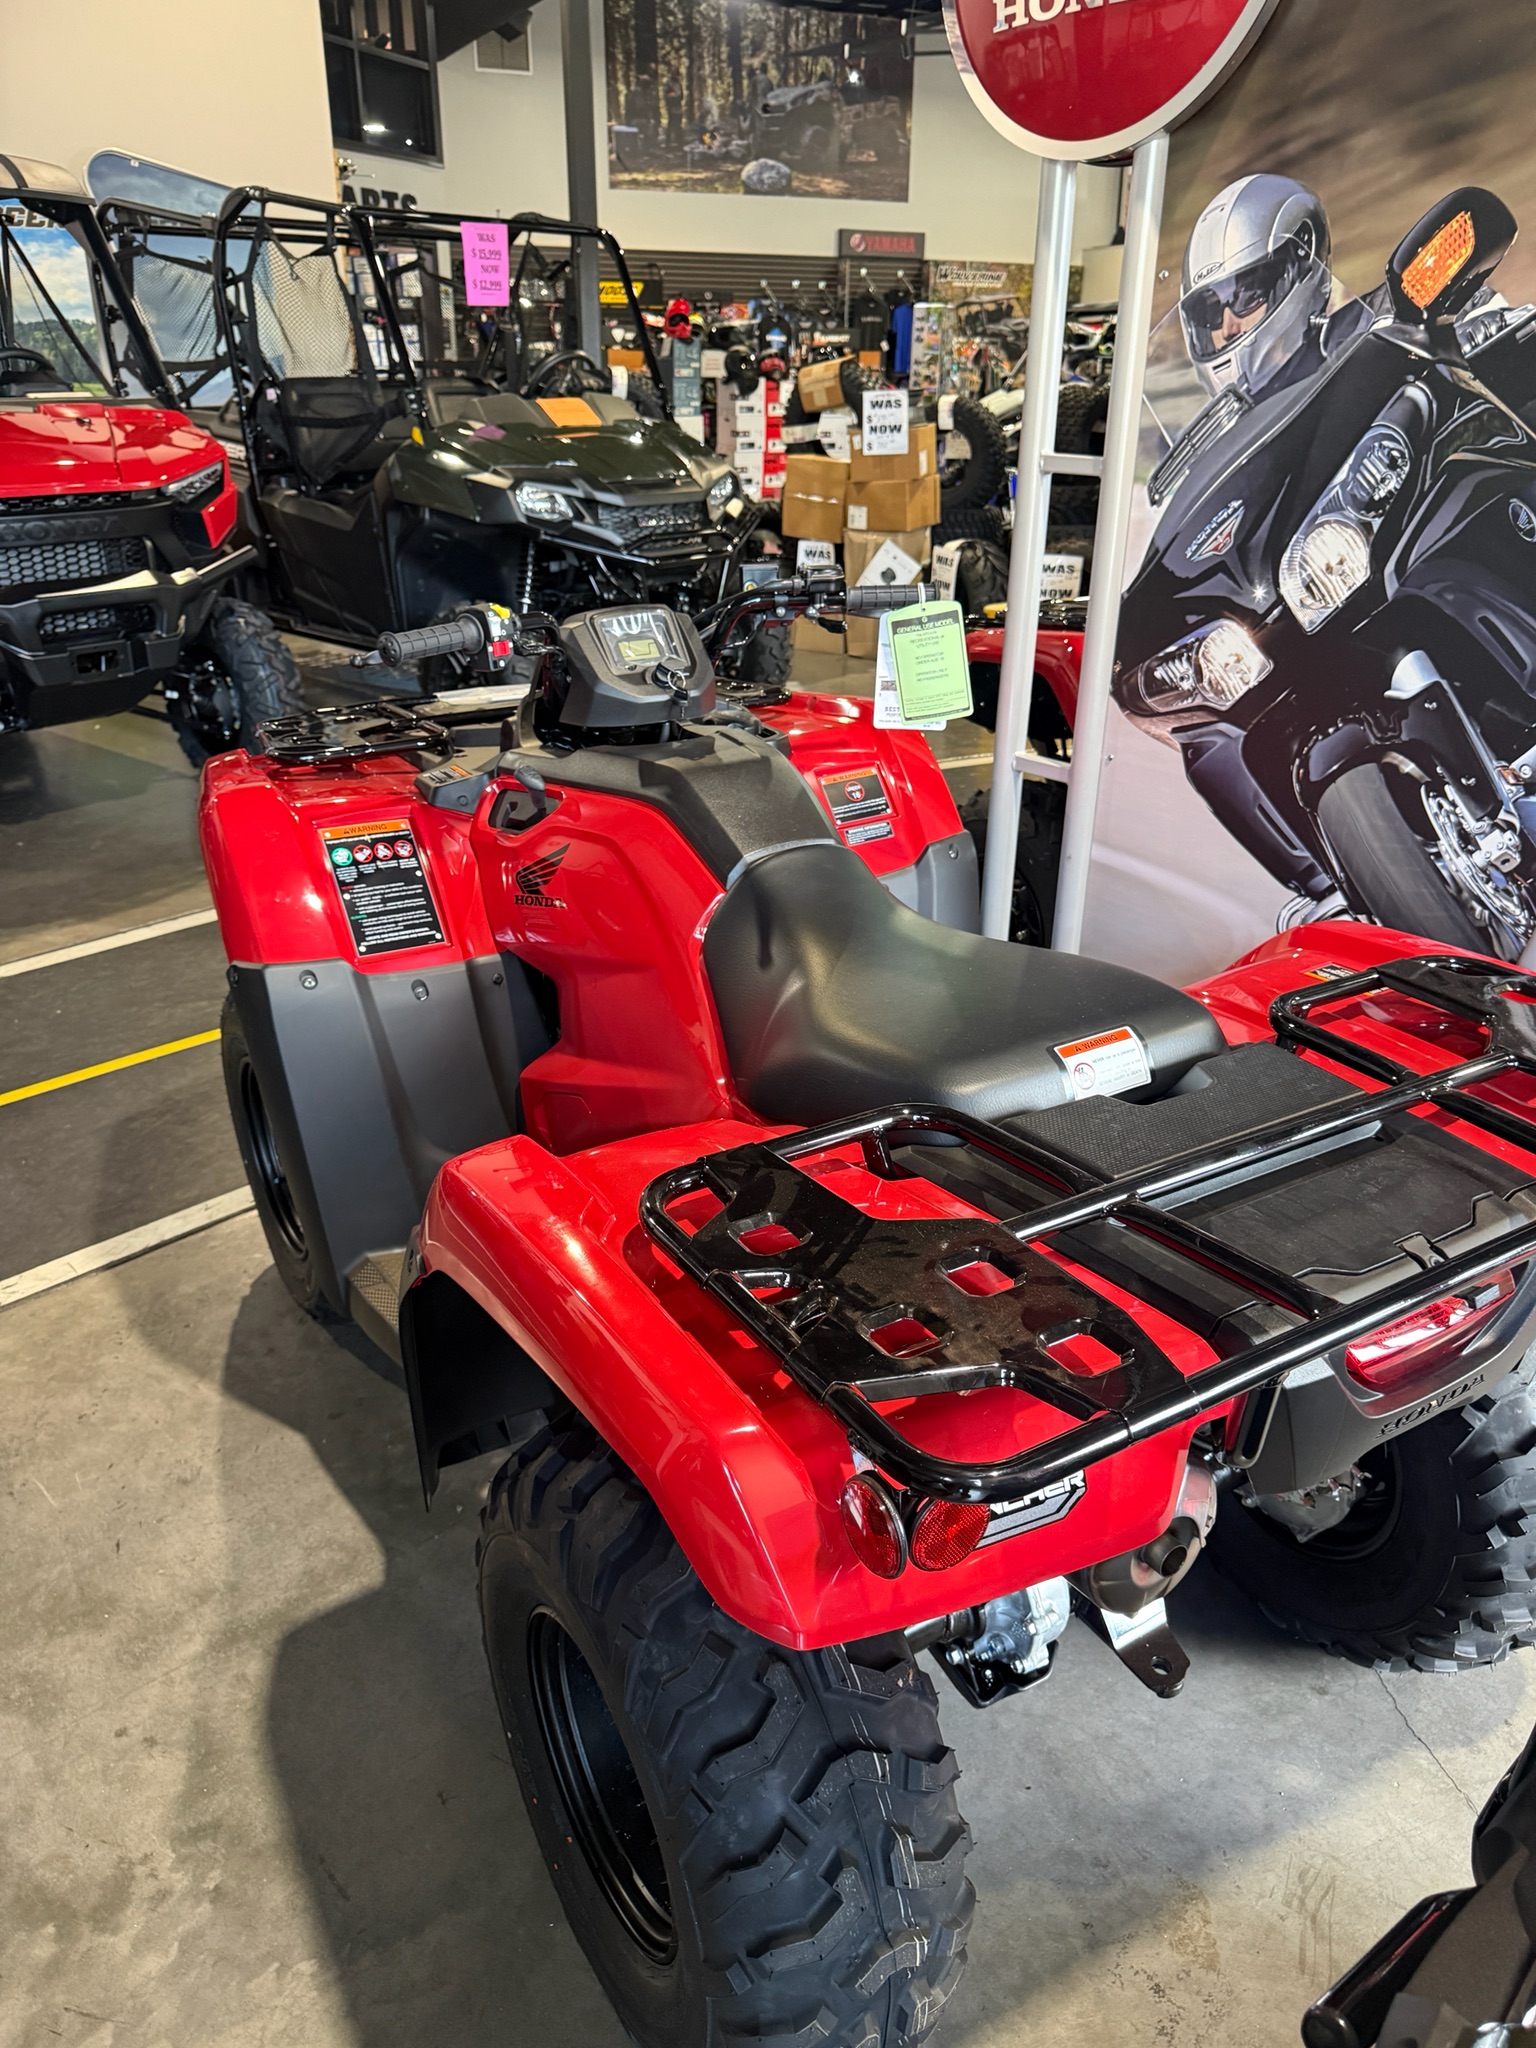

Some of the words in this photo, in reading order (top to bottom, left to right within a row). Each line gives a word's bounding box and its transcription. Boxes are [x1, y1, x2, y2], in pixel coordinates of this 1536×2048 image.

[477, 233, 496, 243] WAS
[865, 235, 915, 254] YAMAHA
[480, 264, 500, 274] NOW
[870, 399, 902, 410] WAS
[869, 424, 902, 435] NOW
[804, 549, 832, 560] WAS
[935, 555, 954, 568] WAS
[1042, 563, 1075, 575] WAS
[1040, 589, 1073, 599] NOW
[839, 772, 867, 780] WARNING
[349, 823, 387, 834] WARNING
[514, 894, 567, 909] HONDA
[1082, 1034, 1118, 1050] WARNING
[1375, 1374, 1485, 1439] HONDA
